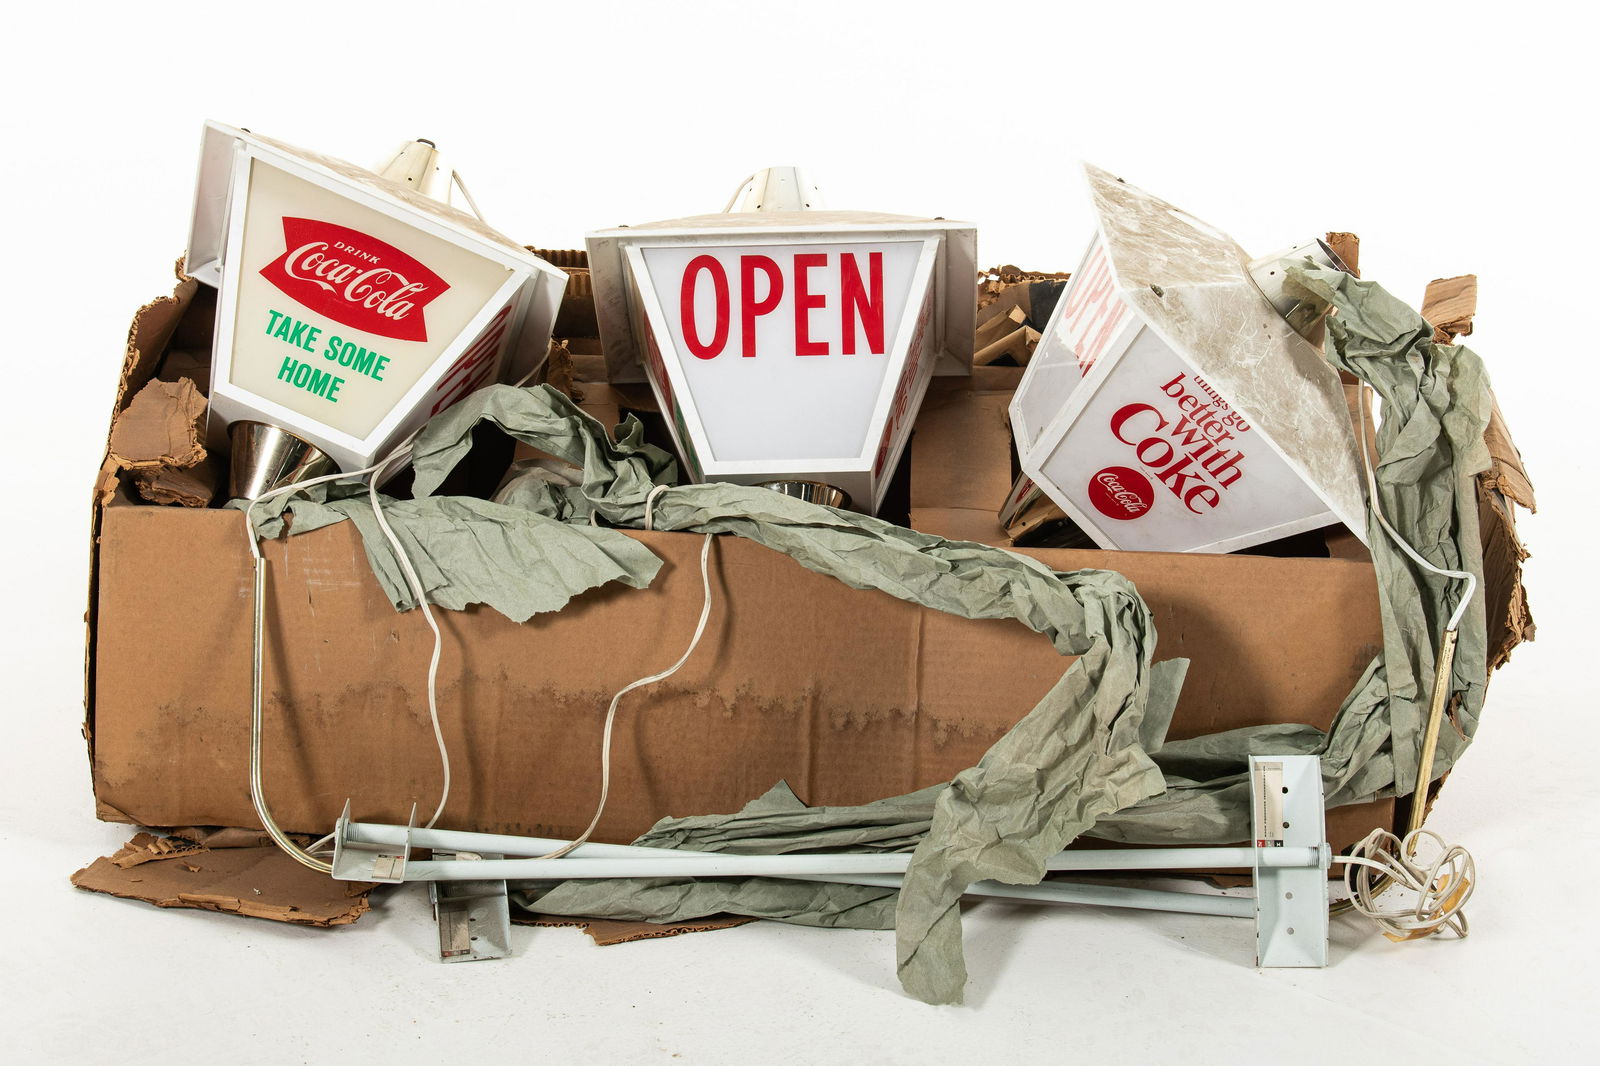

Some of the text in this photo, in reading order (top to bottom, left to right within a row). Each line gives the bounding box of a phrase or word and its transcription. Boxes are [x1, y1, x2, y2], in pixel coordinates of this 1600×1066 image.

[284, 241, 431, 321] Coca-Cola
[333, 241, 381, 265] DRINK
[680, 251, 885, 361] OPEN
[265, 309, 391, 382] TAKE SOME
[277, 356, 345, 403] HOME
[1159, 372, 1235, 446] better
[1110, 403, 1220, 514] Coke
[1171, 413, 1245, 490] with
[1096, 472, 1148, 513] Coca-Cola
